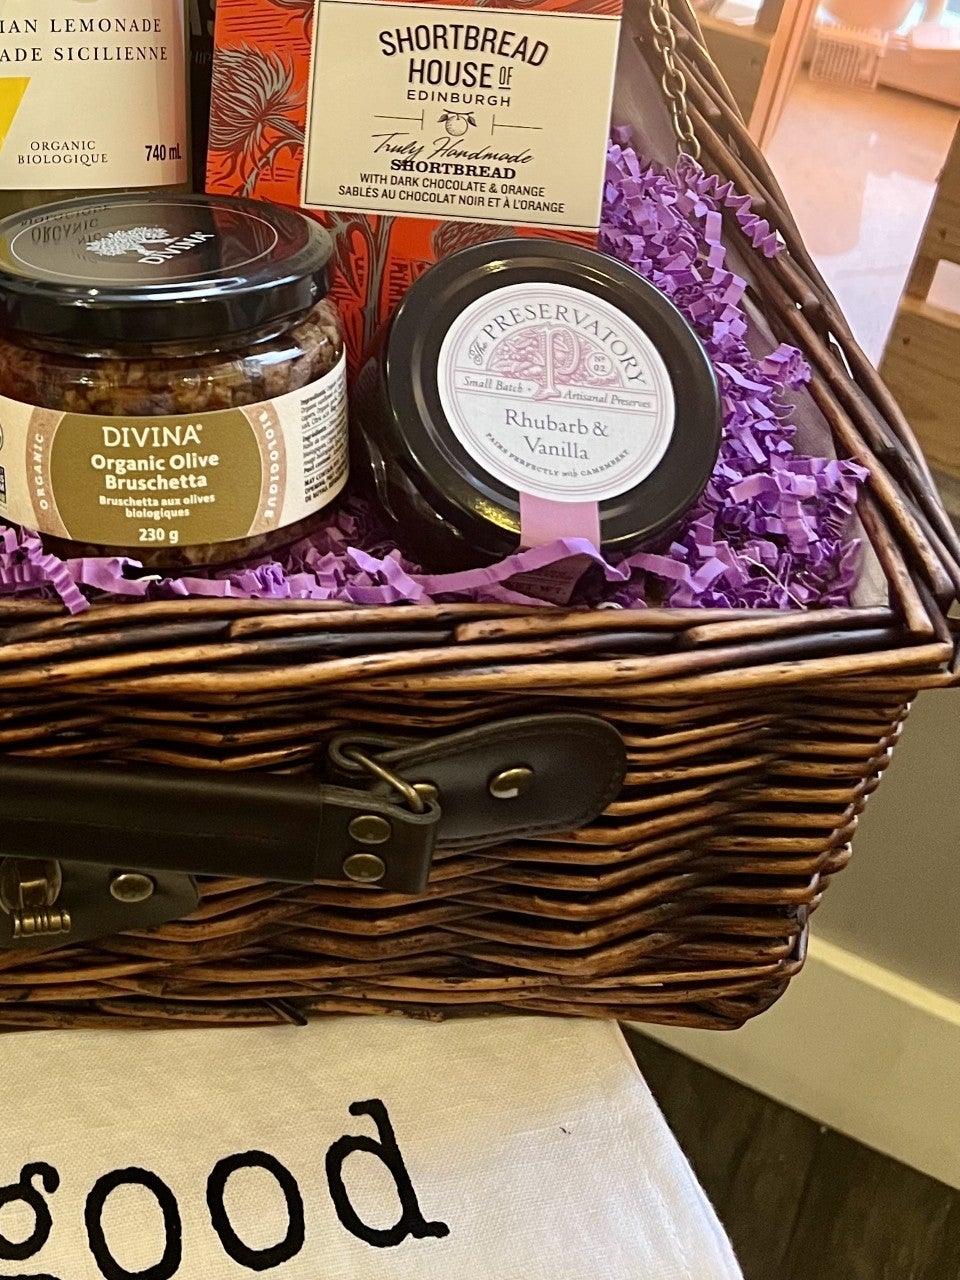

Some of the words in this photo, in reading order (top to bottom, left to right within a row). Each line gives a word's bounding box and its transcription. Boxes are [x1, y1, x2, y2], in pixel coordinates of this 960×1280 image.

[50, 17, 162, 34] LEMONADE
[53, 46, 169, 62] SICILIENNE
[378, 24, 549, 67] SHORTBREAD
[407, 57, 495, 89] HOUSE
[498, 66, 514, 88] OF
[406, 89, 512, 108] EDINBURGH
[17, 153, 109, 167] BIOLOGIQUE
[144, 144, 166, 162] 740
[30, 140, 97, 151] ORGANIC
[371, 132, 425, 165] Truly
[427, 136, 535, 165] Handmade
[390, 158, 516, 180] SHORTBREAD
[359, 172, 388, 185] WITH
[390, 175, 420, 188] DARK
[422, 177, 487, 193] CHOCOLATE
[488, 183, 498, 194] &
[500, 183, 546, 198] ORANGE
[381, 189, 396, 200] AU
[398, 189, 457, 206] CHOCOLAT
[458, 194, 486, 207] NOIR
[487, 197, 502, 208] ET
[502, 194, 511, 209] À
[512, 198, 566, 214] L'ORANGE
[138, 232, 216, 265] DIVINA
[468, 336, 489, 366] The
[482, 303, 647, 385] PRESERVATORY
[593, 364, 606, 373] 02
[463, 375, 492, 389] Small
[495, 380, 523, 393] Batch
[563, 389, 608, 404] Artisanal
[610, 393, 652, 408] Preserves
[505, 408, 589, 436] Rhubarb
[592, 421, 609, 438] &
[102, 424, 202, 448] DIVINA
[523, 435, 590, 460] Vanilla
[33, 433, 49, 510] ORGANIC
[90, 453, 166, 475] Organic
[169, 452, 220, 470] Olive
[509, 452, 560, 477] PERFECTLY
[561, 469, 579, 478] with
[580, 449, 630, 477] CAMEMBERT
[105, 473, 208, 491] Bruschetta
[99, 495, 159, 507] Bruschetta
[161, 497, 181, 507] aux
[182, 493, 216, 506] olives
[125, 507, 190, 521] biologiques
[138, 527, 166, 542] 230
[168, 529, 179, 544] g
